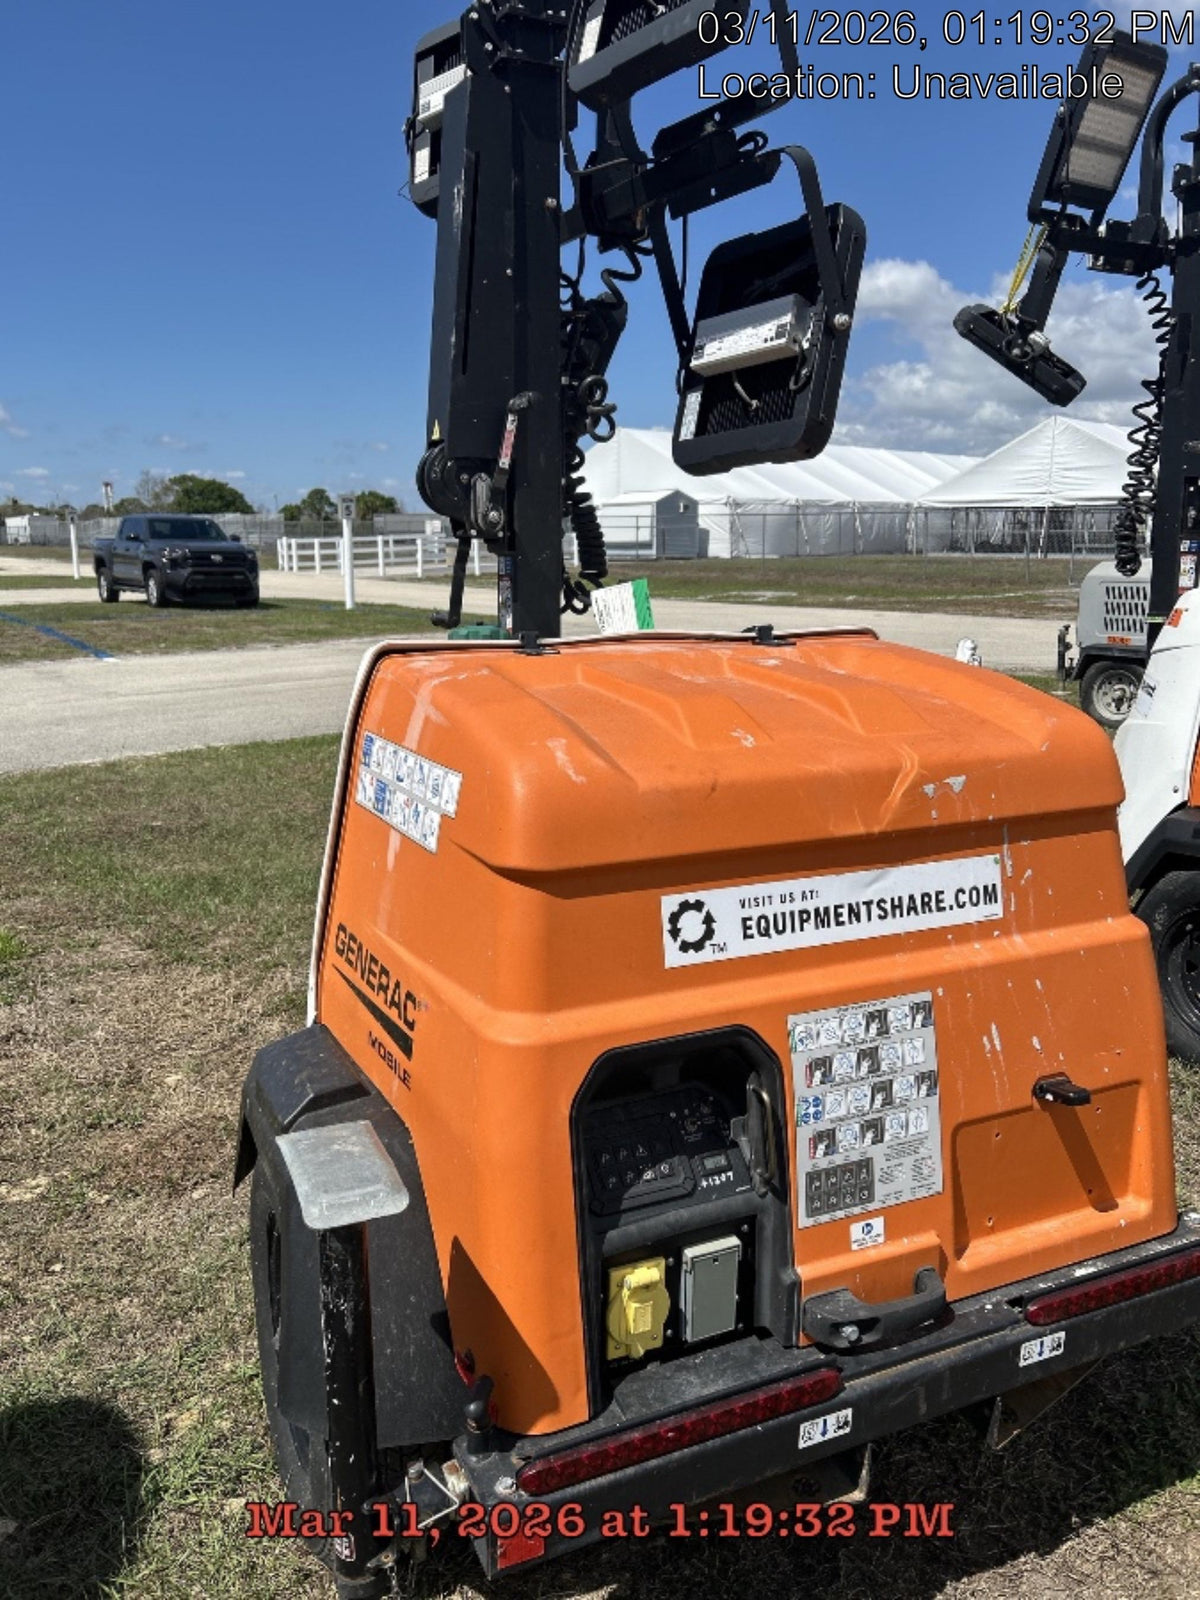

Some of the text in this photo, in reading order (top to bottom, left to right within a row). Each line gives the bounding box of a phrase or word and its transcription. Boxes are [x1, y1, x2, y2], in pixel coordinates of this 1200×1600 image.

[739, 896, 773, 909] VISIT
[780, 892, 796, 904] US
[741, 883, 999, 940] EQUIPMENTSHARE.COM
[335, 922, 417, 1032] GENERAC
